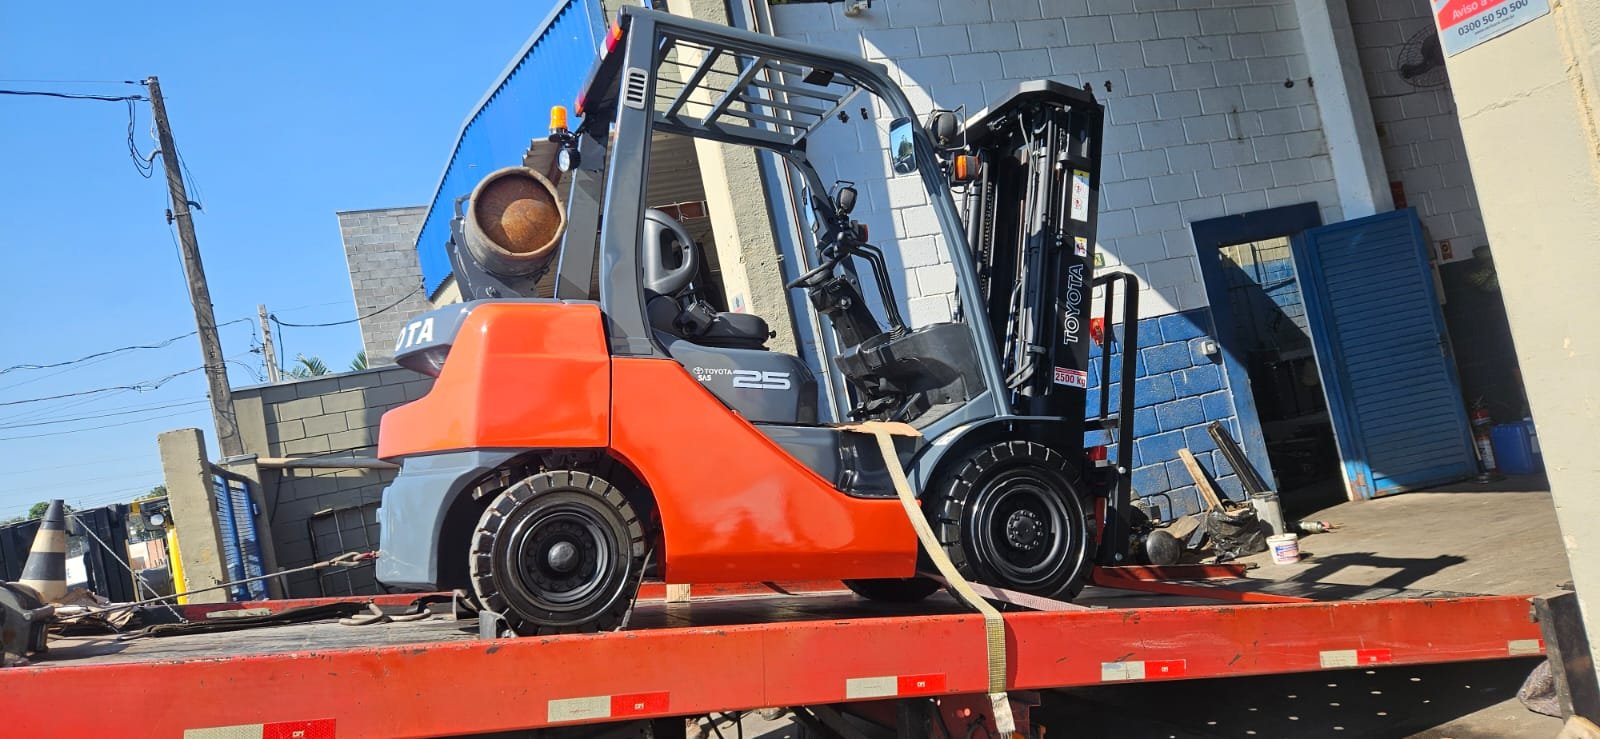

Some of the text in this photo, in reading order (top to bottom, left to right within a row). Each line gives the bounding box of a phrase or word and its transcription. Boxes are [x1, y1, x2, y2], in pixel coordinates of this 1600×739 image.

[1452, 2, 1479, 20] Aviso
[1458, 20, 1481, 36] 0300
[1482, 14, 1494, 25] 50
[1496, 7, 1508, 19] 50
[1509, 0, 1528, 12] 500
[1064, 263, 1084, 344] TOYOTA
[733, 370, 791, 390] 25
[1055, 373, 1075, 383] 2500
